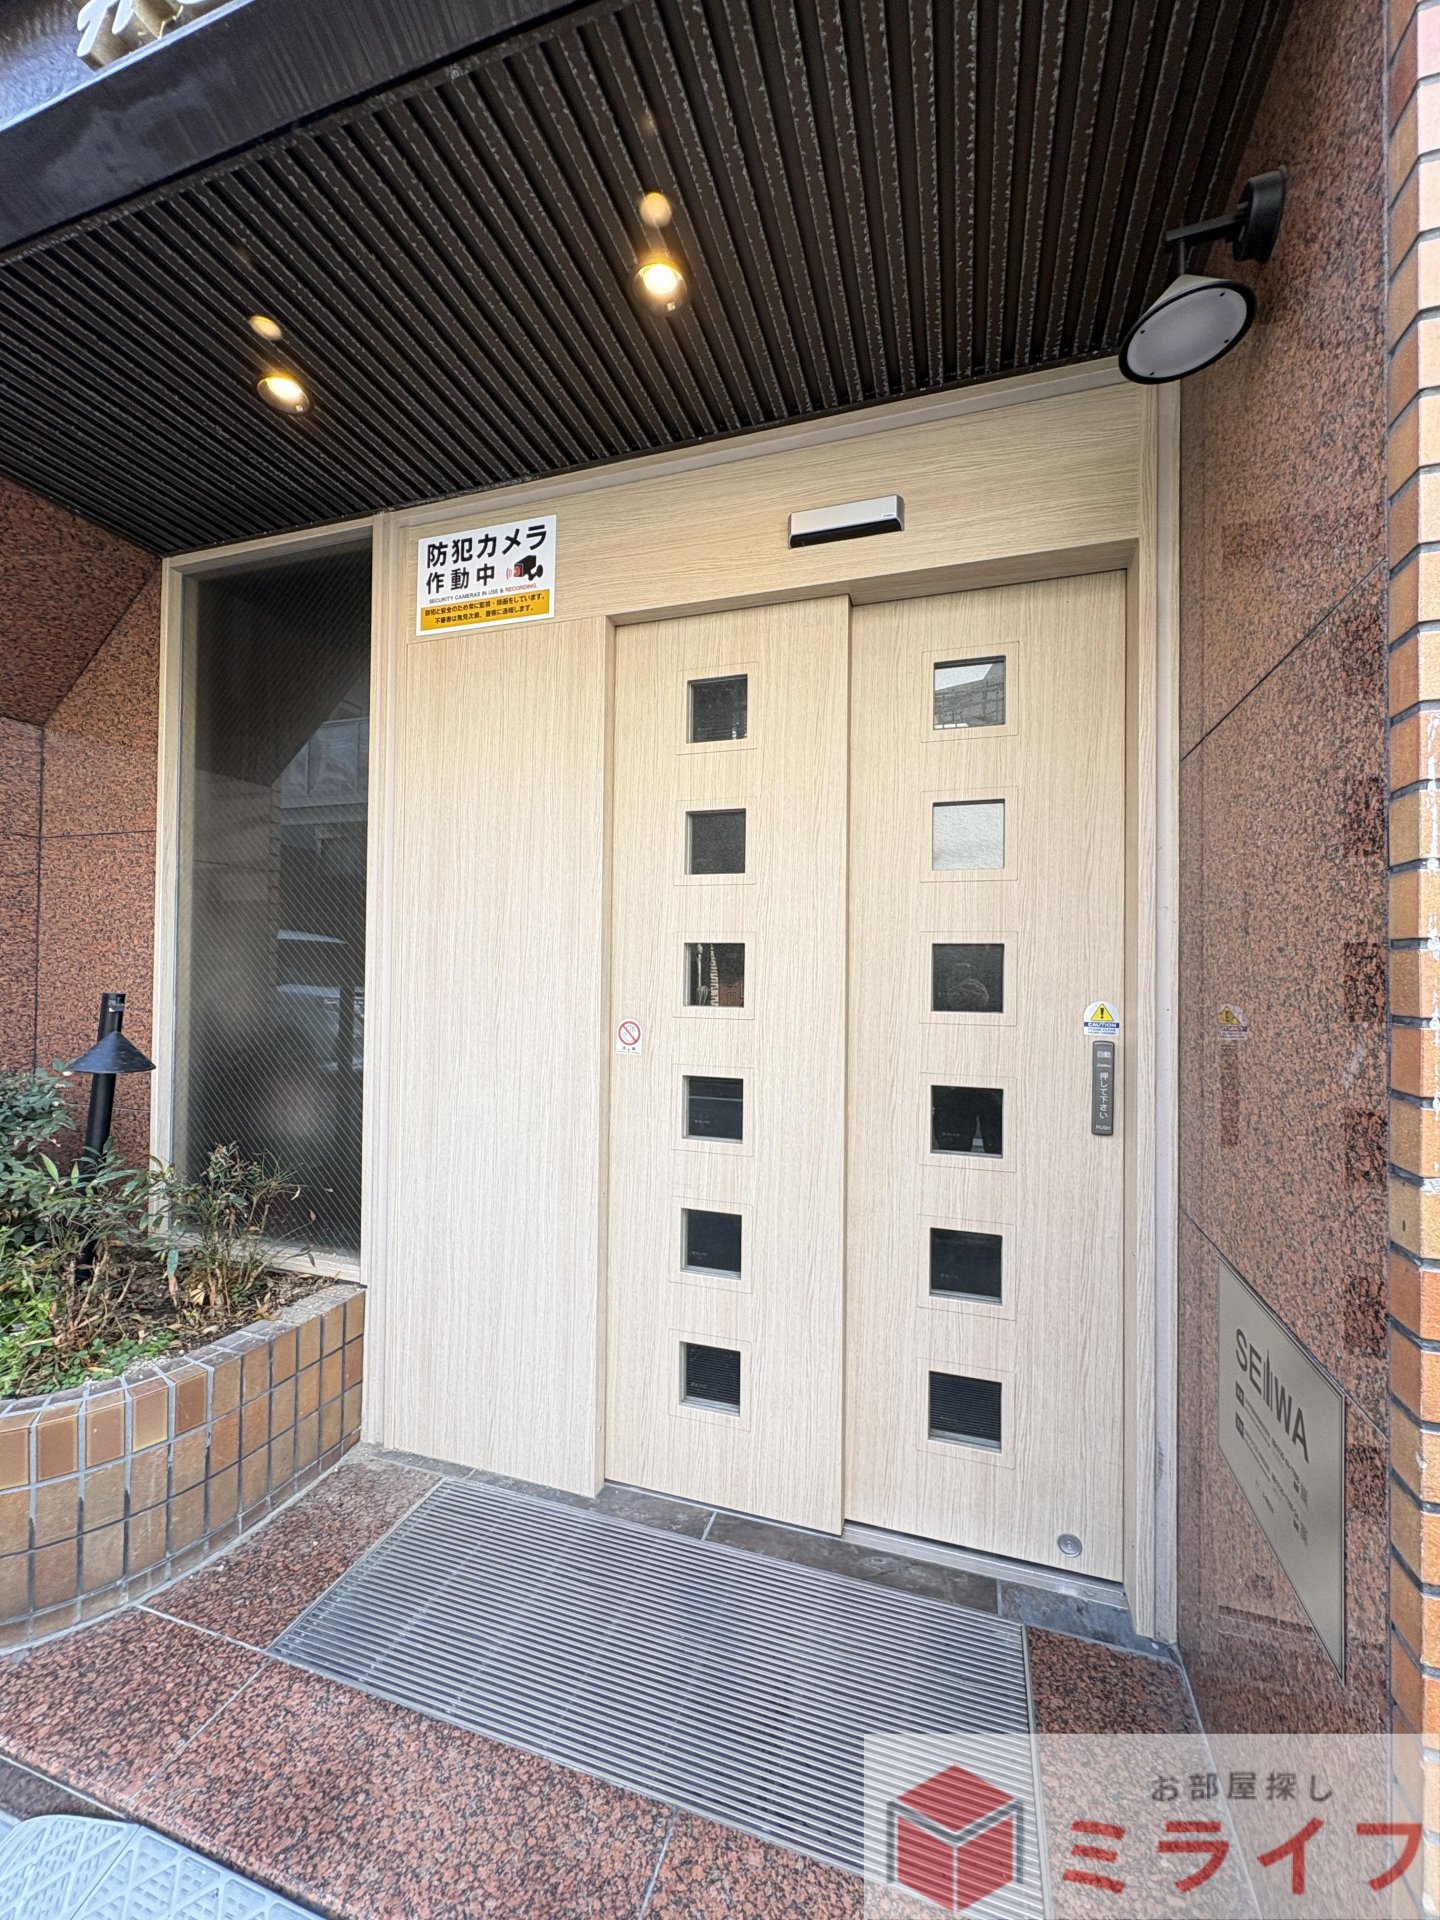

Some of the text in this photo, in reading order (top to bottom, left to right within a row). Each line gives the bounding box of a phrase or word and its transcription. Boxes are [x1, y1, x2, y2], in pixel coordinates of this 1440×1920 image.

[427, 524, 547, 568] 防犯カメラ
[426, 563, 495, 595] 作動中
[429, 596, 453, 604] SECURITY
[454, 592, 481, 601] CAMERAS
[1099, 1072, 1108, 1118] 押して下さい
